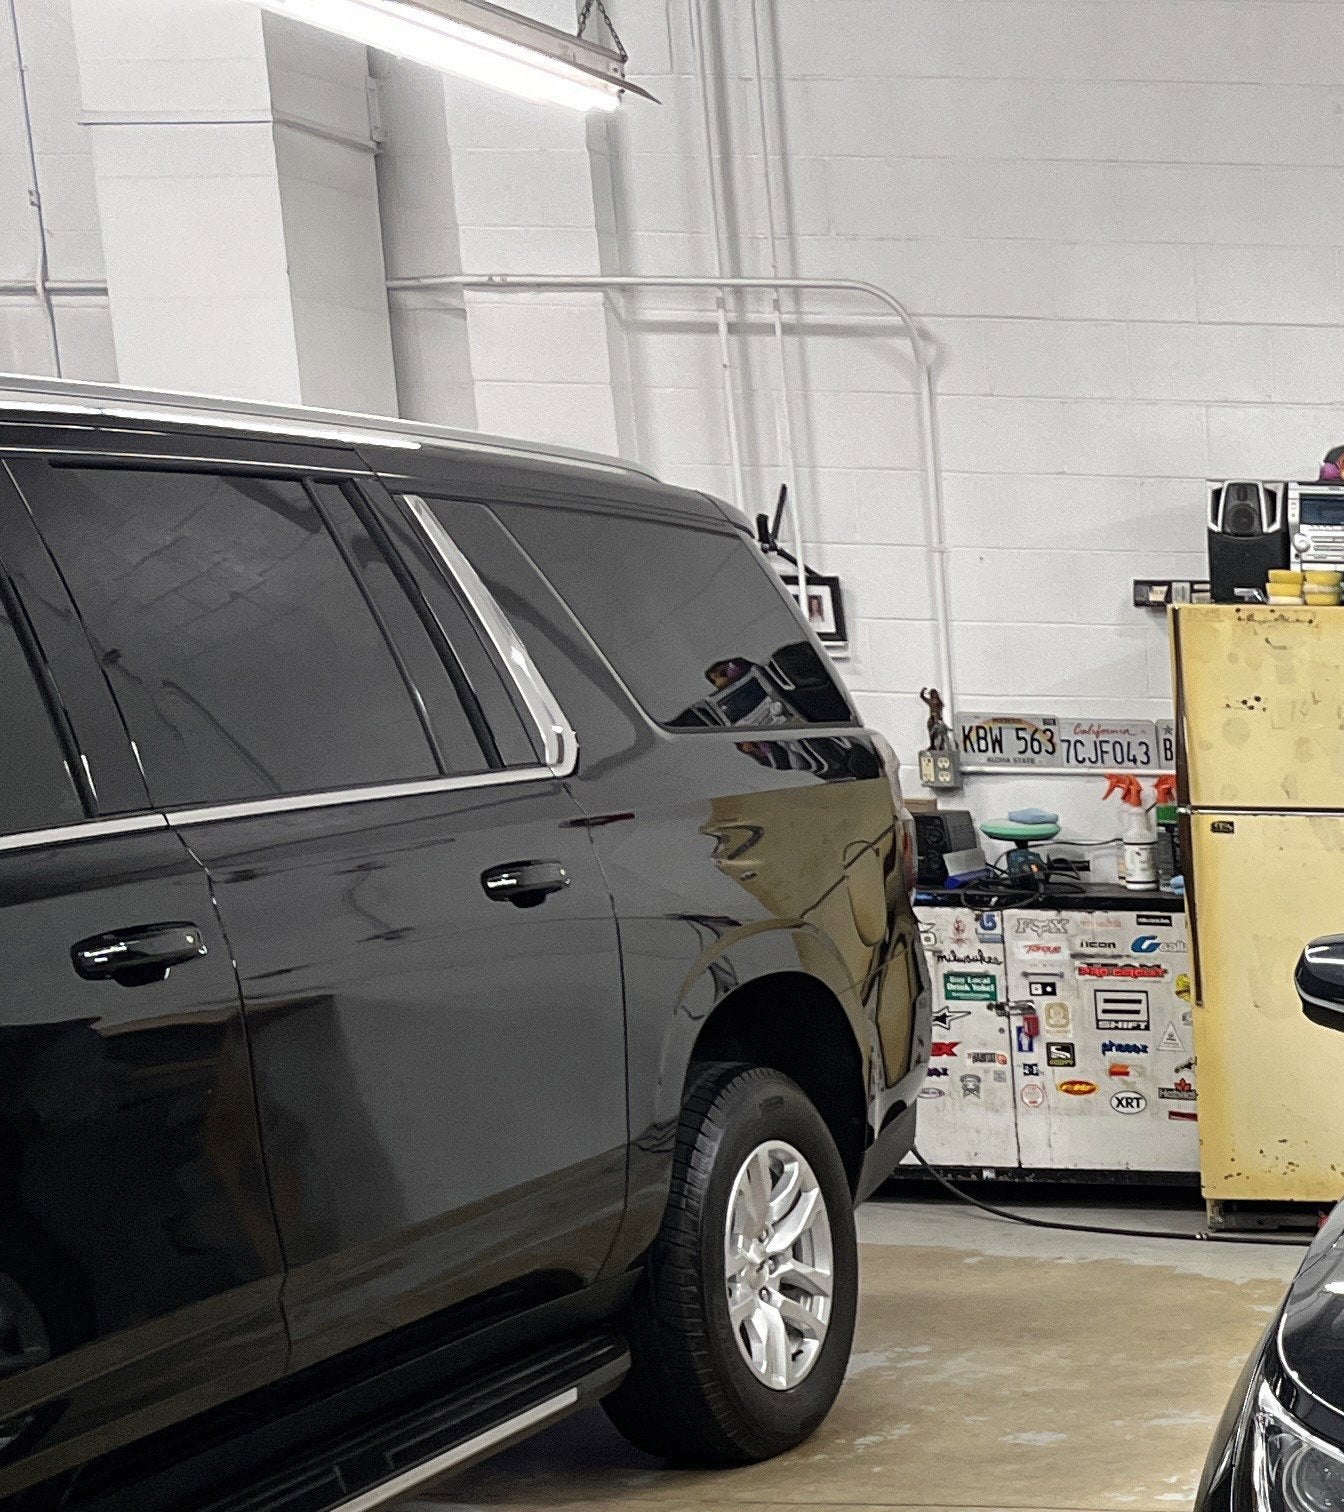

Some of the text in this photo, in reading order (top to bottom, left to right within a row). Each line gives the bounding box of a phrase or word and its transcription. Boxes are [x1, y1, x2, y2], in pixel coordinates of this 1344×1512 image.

[962, 725, 1056, 755] KBW 563
[1061, 738, 1150, 765] 7CJF043
[1098, 1021, 1147, 1029] SHIFT
[1115, 1096, 1143, 1108] XRT
